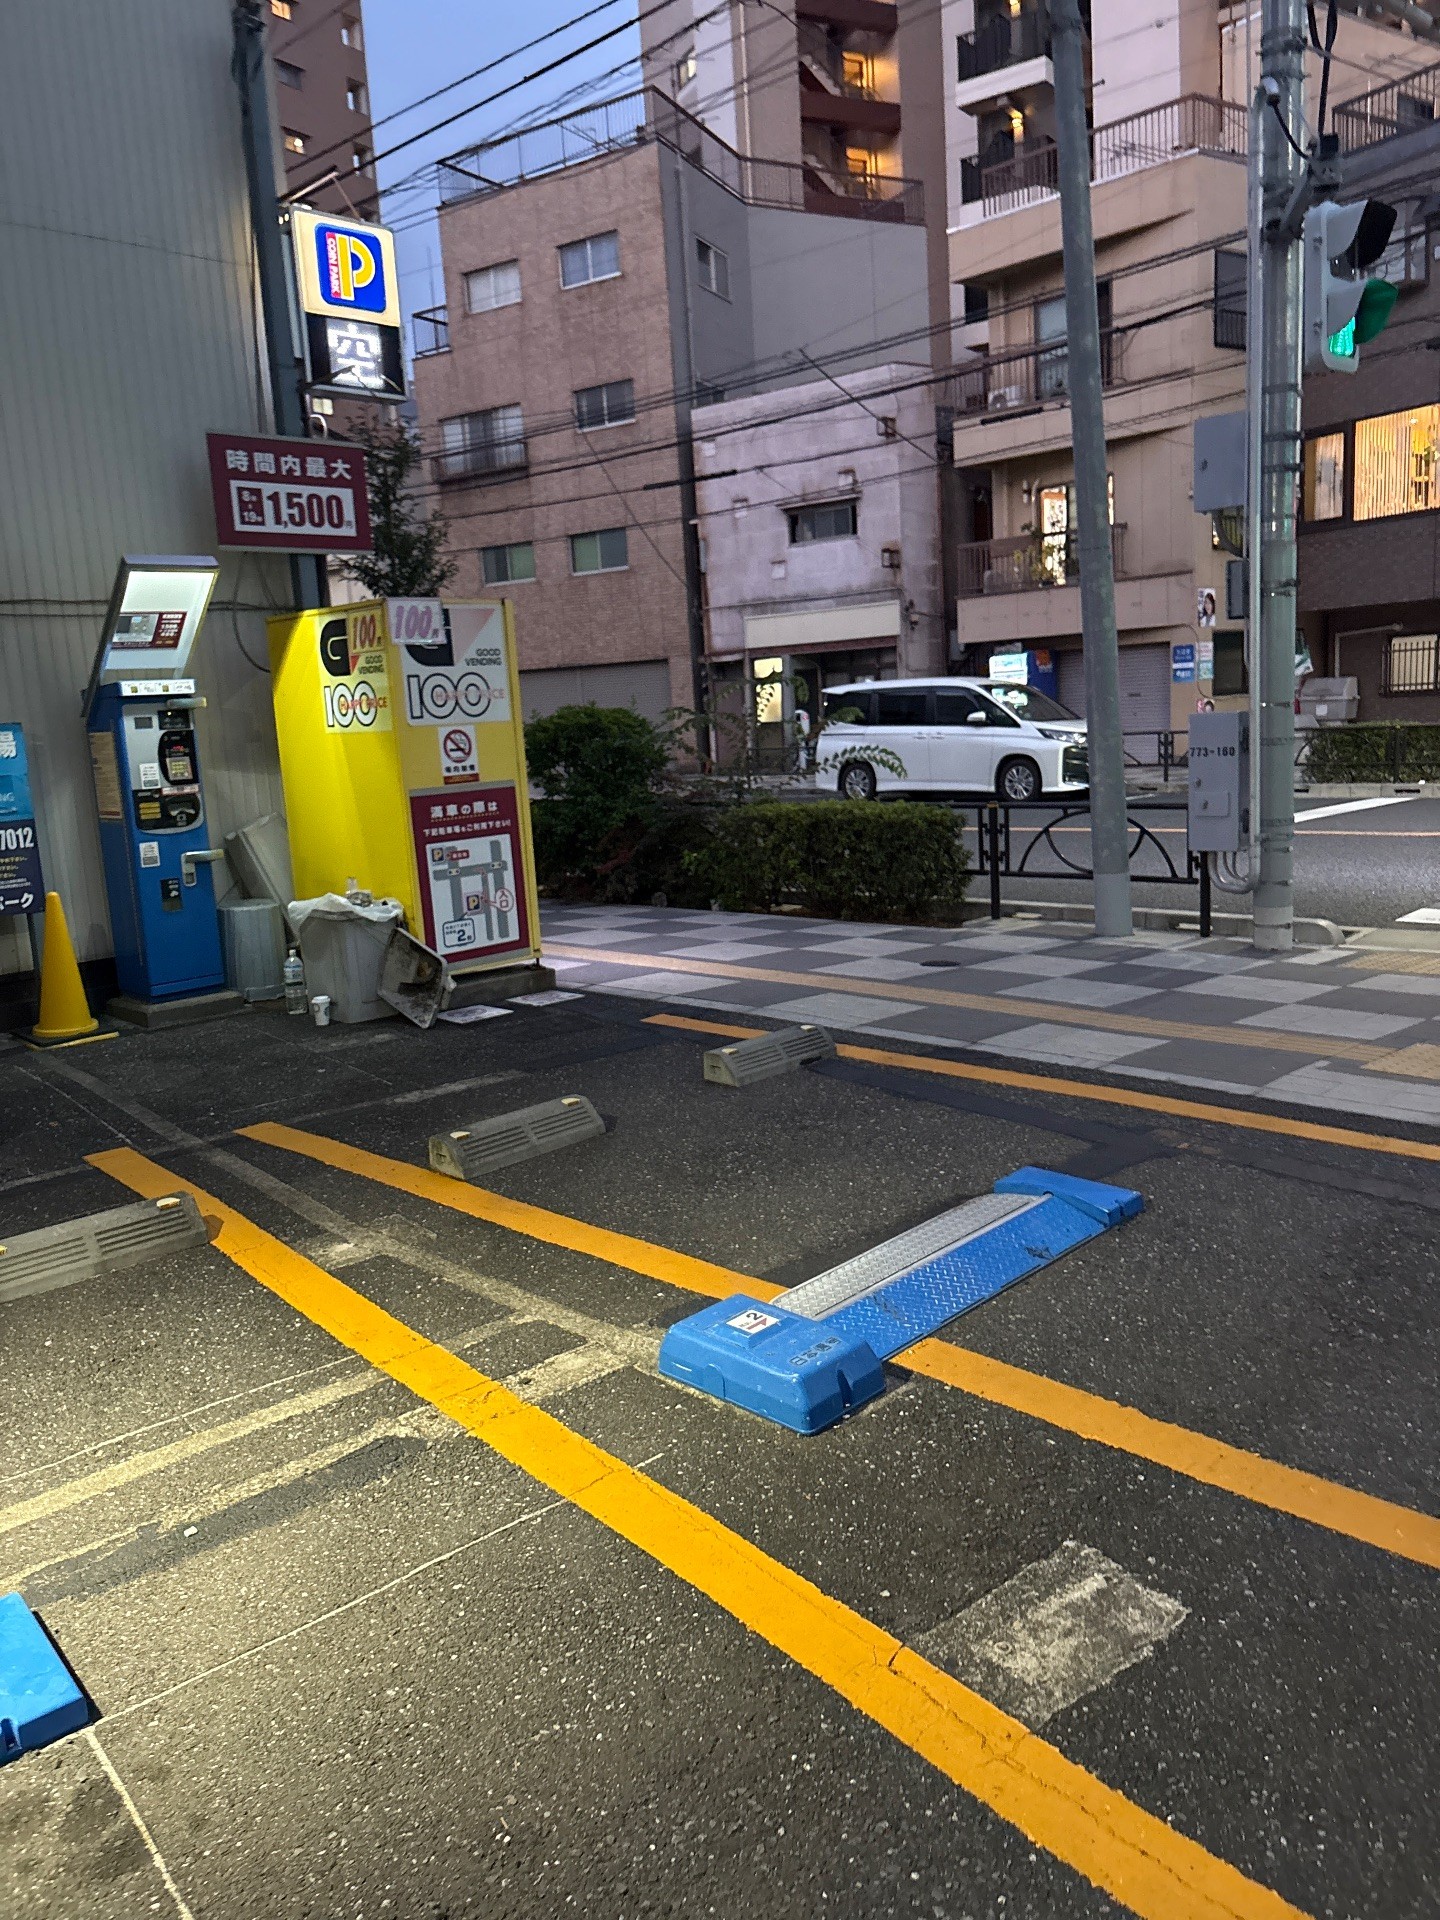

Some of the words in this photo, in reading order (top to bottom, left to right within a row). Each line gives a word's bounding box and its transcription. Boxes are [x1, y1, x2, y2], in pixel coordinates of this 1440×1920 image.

[225, 449, 352, 480] 時間内最大
